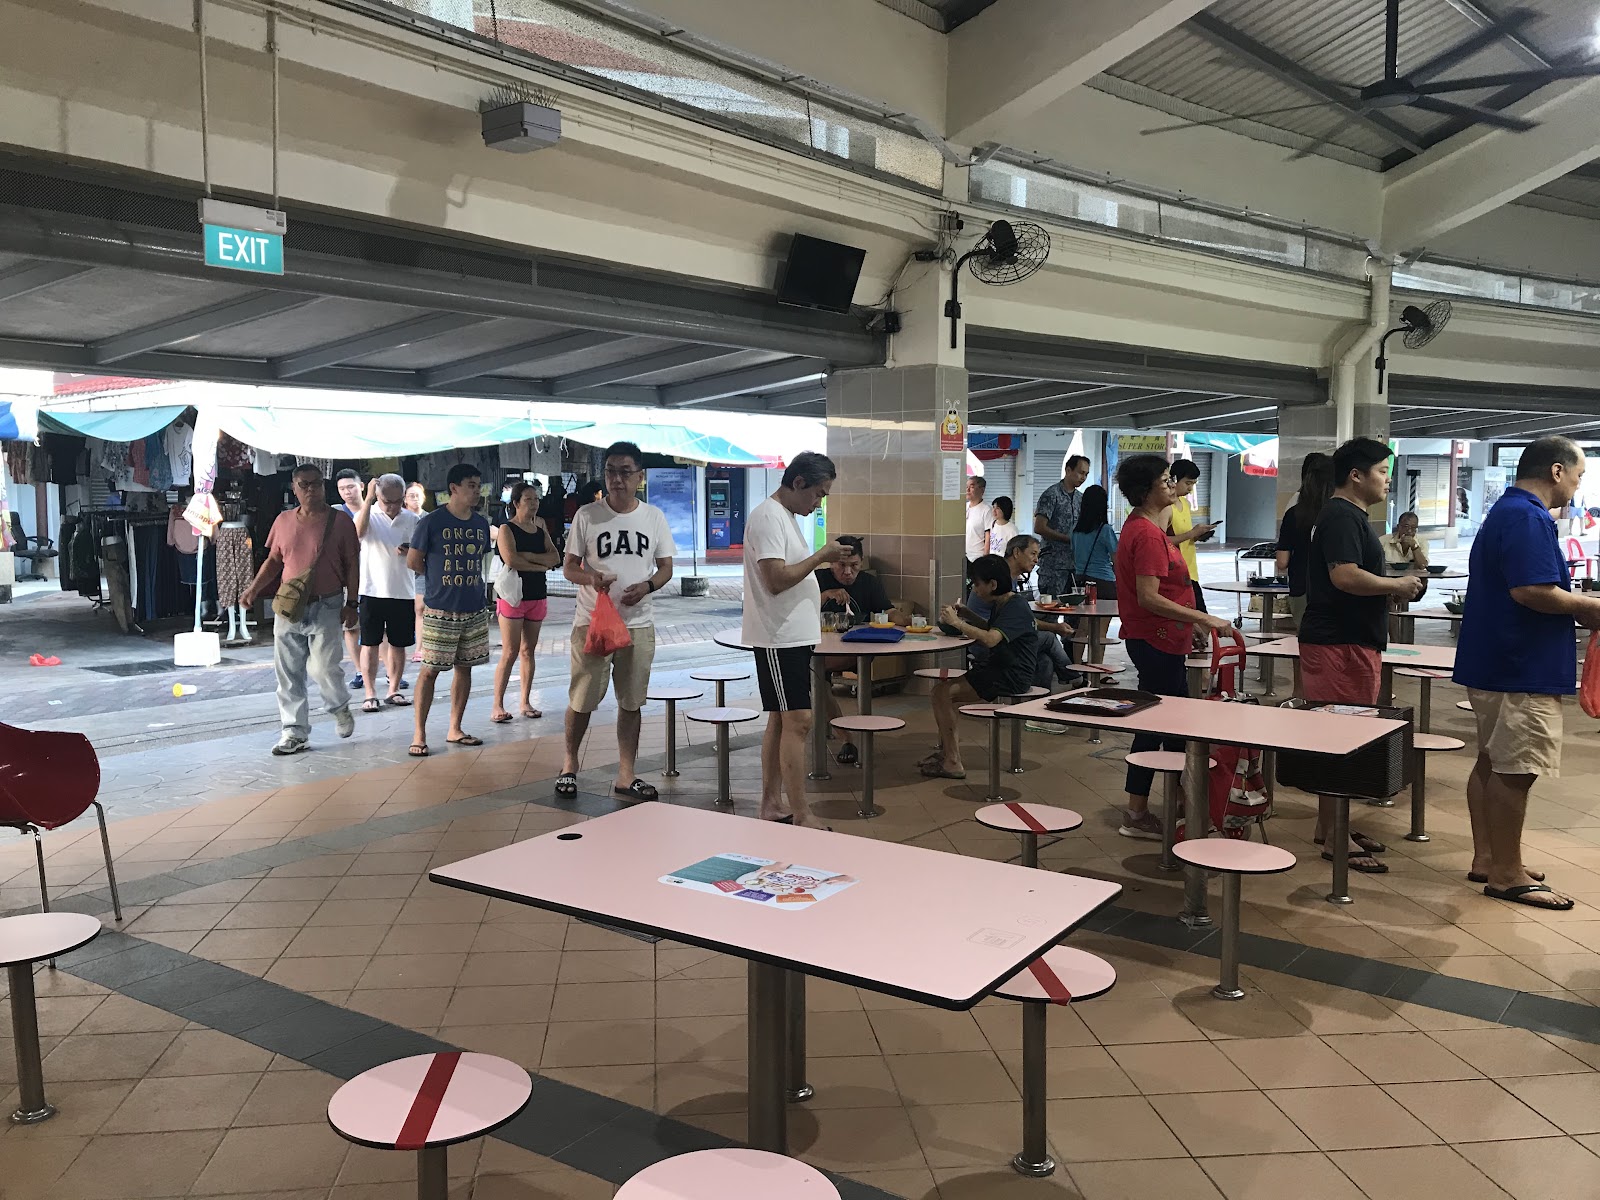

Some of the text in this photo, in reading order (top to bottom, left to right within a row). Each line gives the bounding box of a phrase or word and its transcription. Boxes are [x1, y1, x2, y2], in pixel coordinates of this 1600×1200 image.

[218, 231, 270, 266] EXIT
[1118, 442, 1166, 451] SUPER STOR
[442, 527, 485, 541] ONCE
[596, 530, 650, 559] GAP
[443, 559, 481, 572] BLUE
[441, 574, 480, 587] MOON
